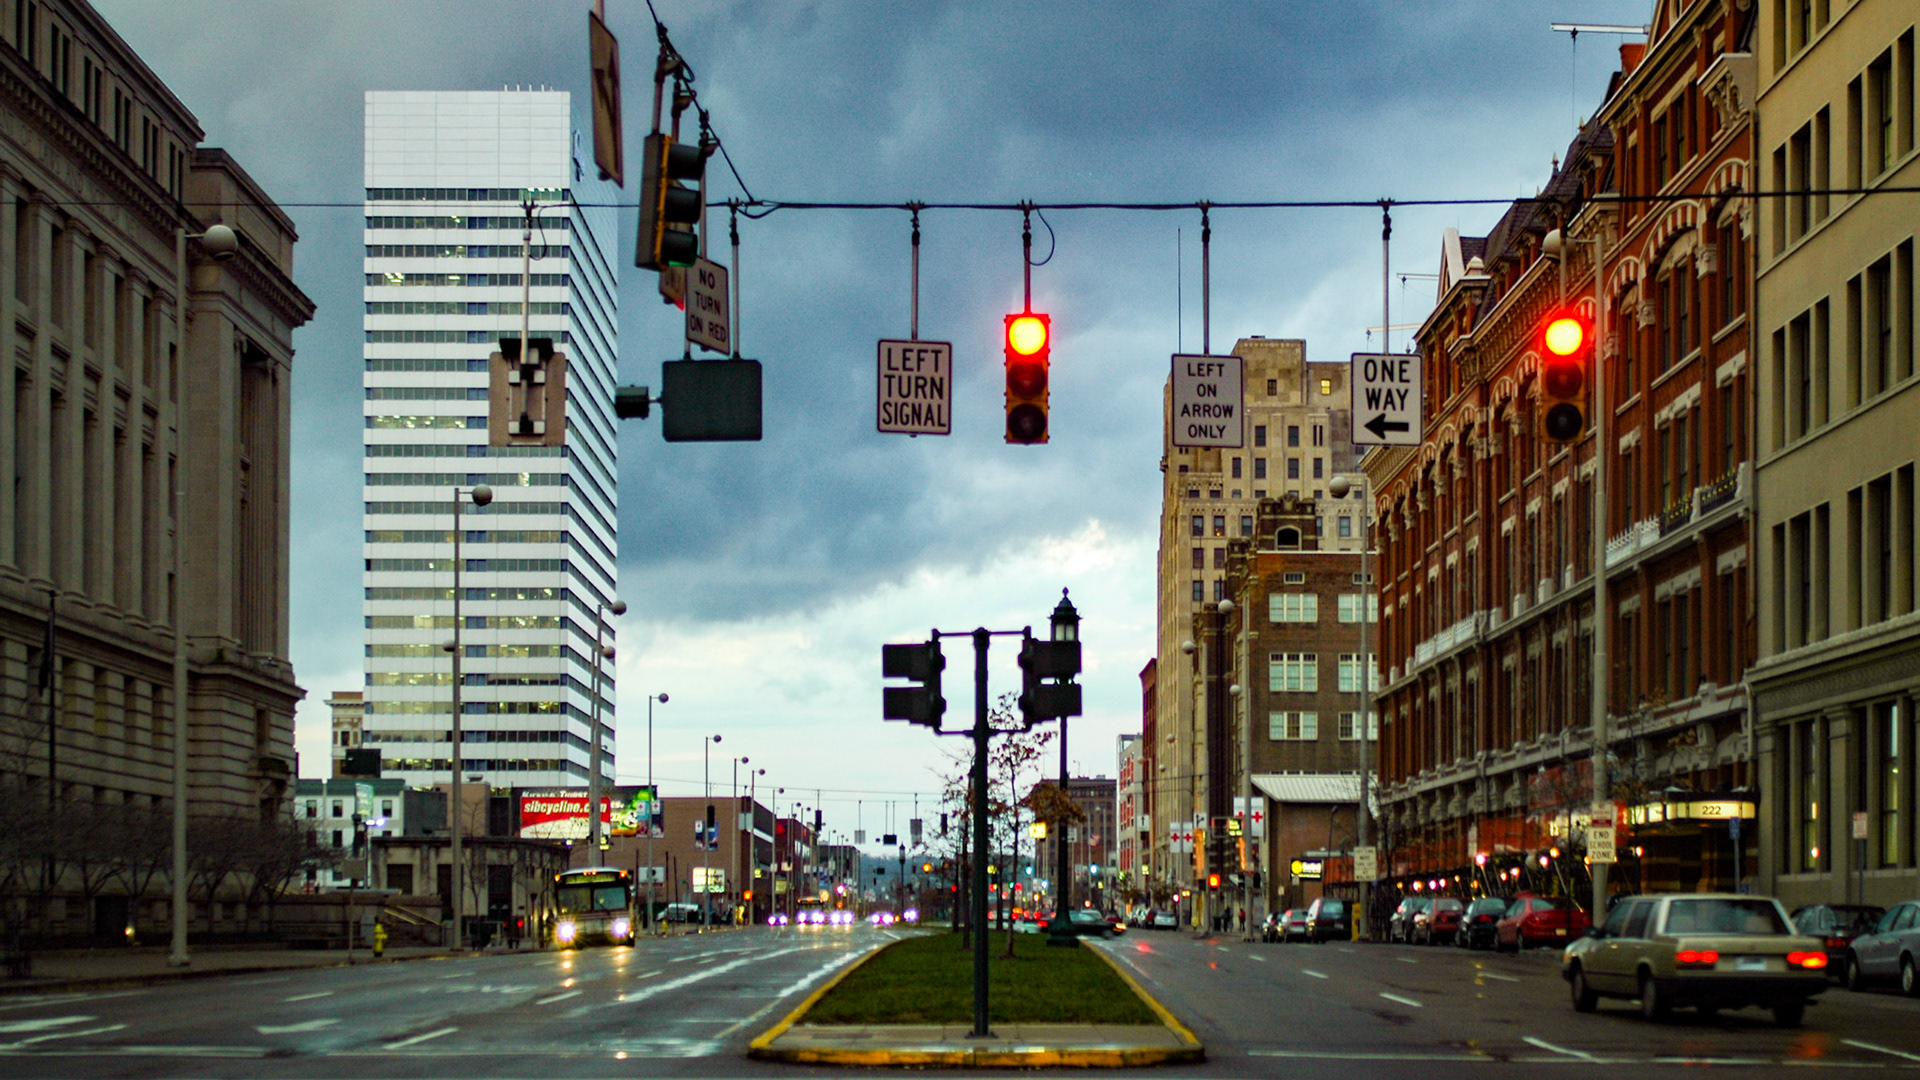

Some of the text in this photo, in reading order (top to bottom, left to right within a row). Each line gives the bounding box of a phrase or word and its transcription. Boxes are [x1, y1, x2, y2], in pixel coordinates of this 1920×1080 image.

[699, 269, 715, 289] NO
[695, 291, 721, 316] TURN
[690, 314, 727, 342] ON RED
[887, 348, 942, 373] LEFT
[1187, 363, 1225, 377] LEFT
[1364, 359, 1411, 383] ONE
[883, 374, 944, 400] TURN
[1196, 383, 1217, 397] ON
[1365, 387, 1409, 411] WAY
[882, 401, 947, 427] SIGNAL
[1181, 404, 1234, 418] ARROW
[1188, 424, 1226, 439] ONLY
[523, 800, 607, 814] sibcycline.cm
[1702, 805, 1721, 816] 222
[1593, 830, 1610, 840] END
[1589, 841, 1613, 850] SCHOOL
[1591, 850, 1612, 860] ZONE
